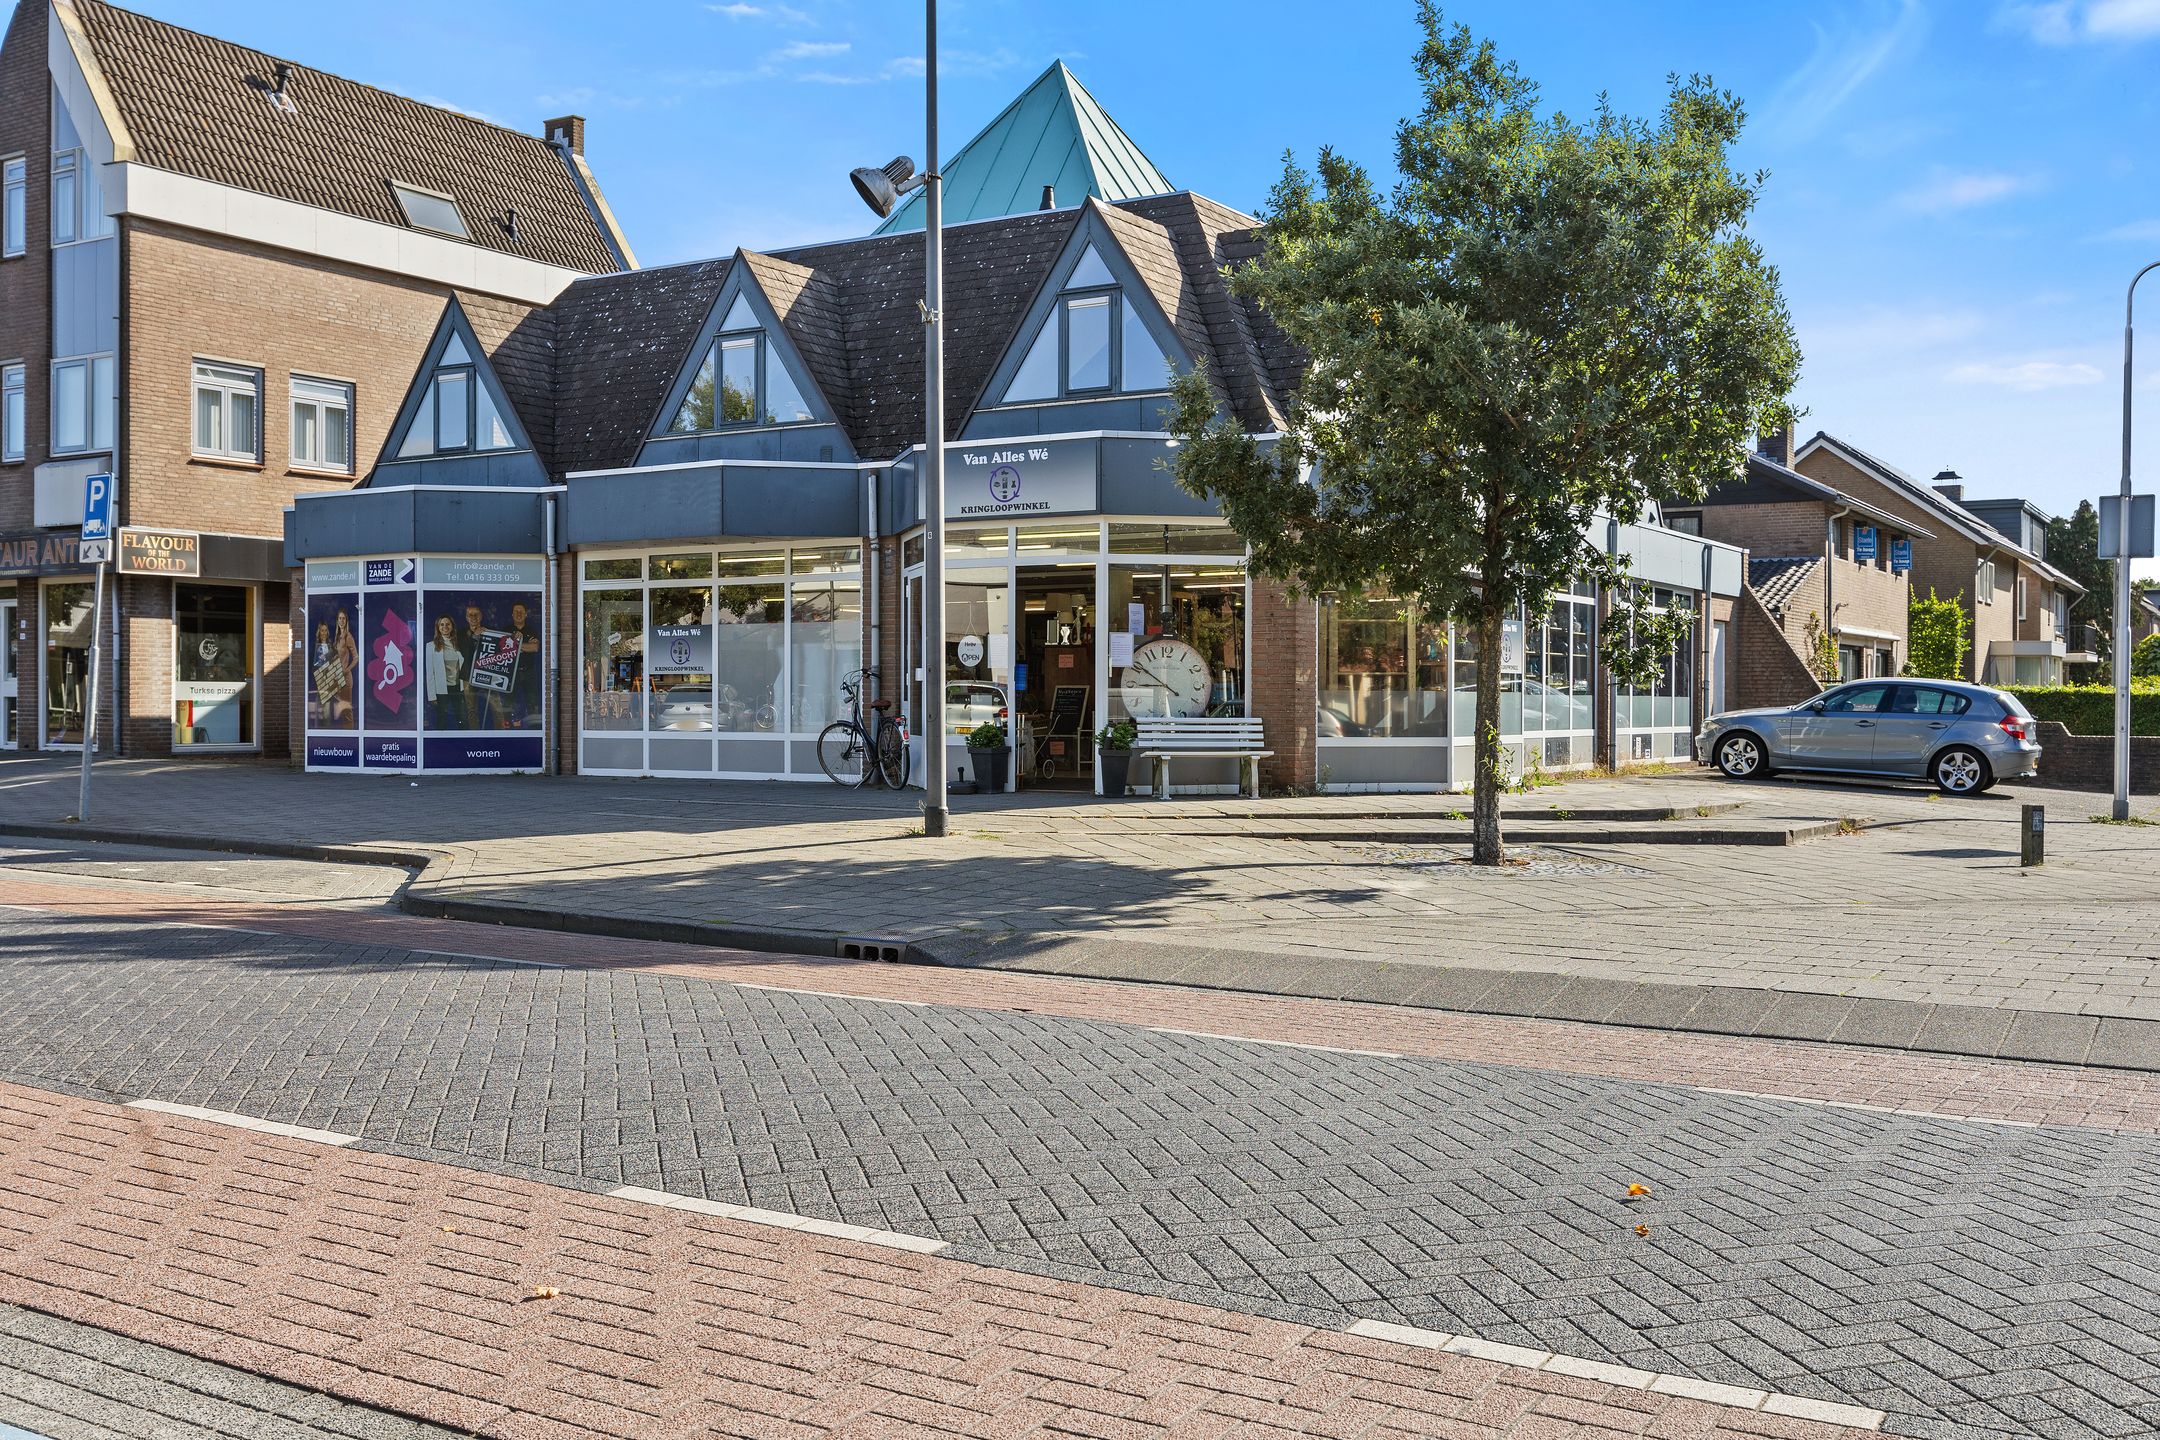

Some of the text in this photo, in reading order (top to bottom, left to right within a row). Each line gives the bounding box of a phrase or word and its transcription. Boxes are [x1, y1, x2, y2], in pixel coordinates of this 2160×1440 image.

[963, 448, 1049, 466] Van Alles Wé
[90, 480, 105, 512] P
[961, 502, 1050, 514] KRINGLOOPWINKEL
[122, 533, 195, 552] FLAVOUR
[0, 537, 78, 566] AURANT
[148, 549, 170, 558] OF THE
[131, 556, 186, 571] WORLD
[454, 561, 515, 571] info@zande.nl
[312, 571, 356, 582] www.zande.nl
[368, 569, 392, 577] ZANDE
[446, 573, 461, 581] Tel.
[487, 574, 502, 582] 333
[657, 628, 701, 637] Van Alles Wé
[481, 642, 496, 653] TE
[1161, 646, 1174, 658] 12
[476, 650, 517, 666] VERKOCHT
[190, 687, 236, 696] Turkse pizza
[313, 747, 353, 757] nieuwbouw
[381, 742, 400, 752] gratis
[365, 752, 416, 764] waardebepaling
[466, 750, 501, 758] wonen
